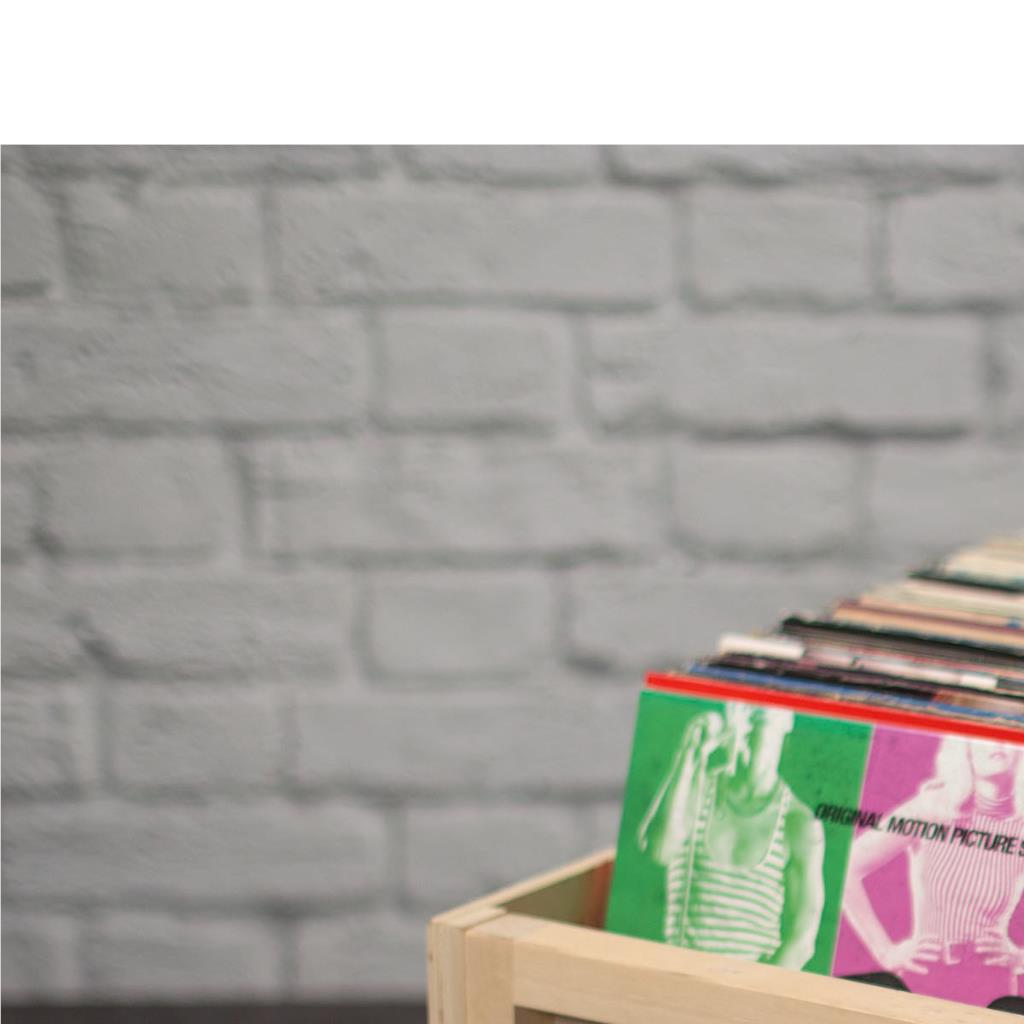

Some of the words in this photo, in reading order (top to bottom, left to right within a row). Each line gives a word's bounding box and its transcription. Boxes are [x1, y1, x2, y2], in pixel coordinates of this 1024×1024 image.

[815, 802, 884, 831] ORIGINAL
[887, 817, 950, 843] MOTION
[950, 827, 1018, 855] PICTURE
